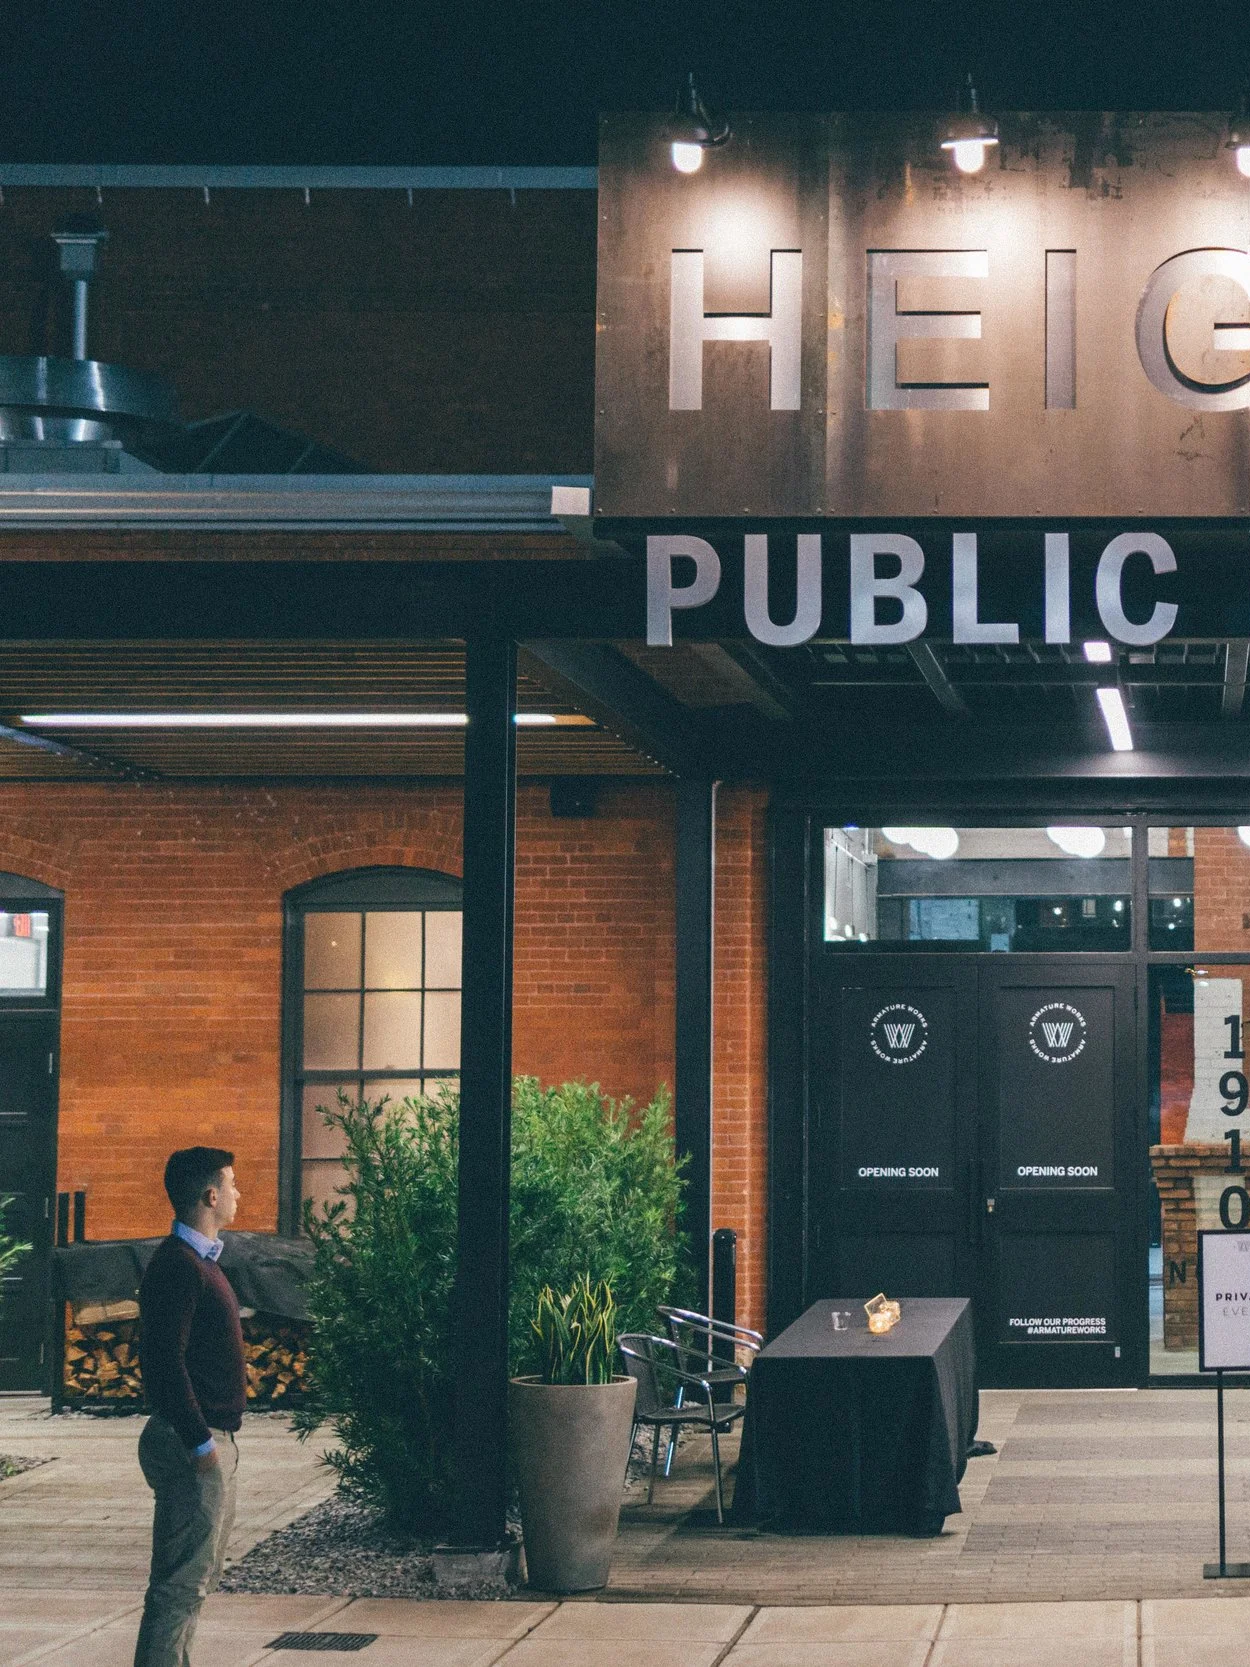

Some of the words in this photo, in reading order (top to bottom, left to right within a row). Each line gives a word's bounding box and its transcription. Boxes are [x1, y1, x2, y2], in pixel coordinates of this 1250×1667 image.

[646, 531, 1179, 648] PUBLIC
[871, 1003, 906, 1028] ARMATURE
[907, 1005, 928, 1028] WORKS
[1030, 1002, 1065, 1027] ARMATURE
[1066, 1004, 1087, 1027] WORKS
[870, 1040, 891, 1062] WORKS
[892, 1040, 928, 1064] ARMATURE
[1029, 1039, 1050, 1061] WORKS
[1051, 1039, 1086, 1063] ARMATURE
[858, 1167, 906, 1178] OPENING
[908, 1167, 939, 1178] SOON
[1017, 1166, 1066, 1177] OPENING
[1067, 1166, 1098, 1177] SOON
[1009, 1317, 1043, 1326] FOLLOW
[1044, 1317, 1061, 1326] OUR
[1062, 1317, 1106, 1326] PROGRESS
[1027, 1326, 1106, 1335] #ARMATUREWORKS
